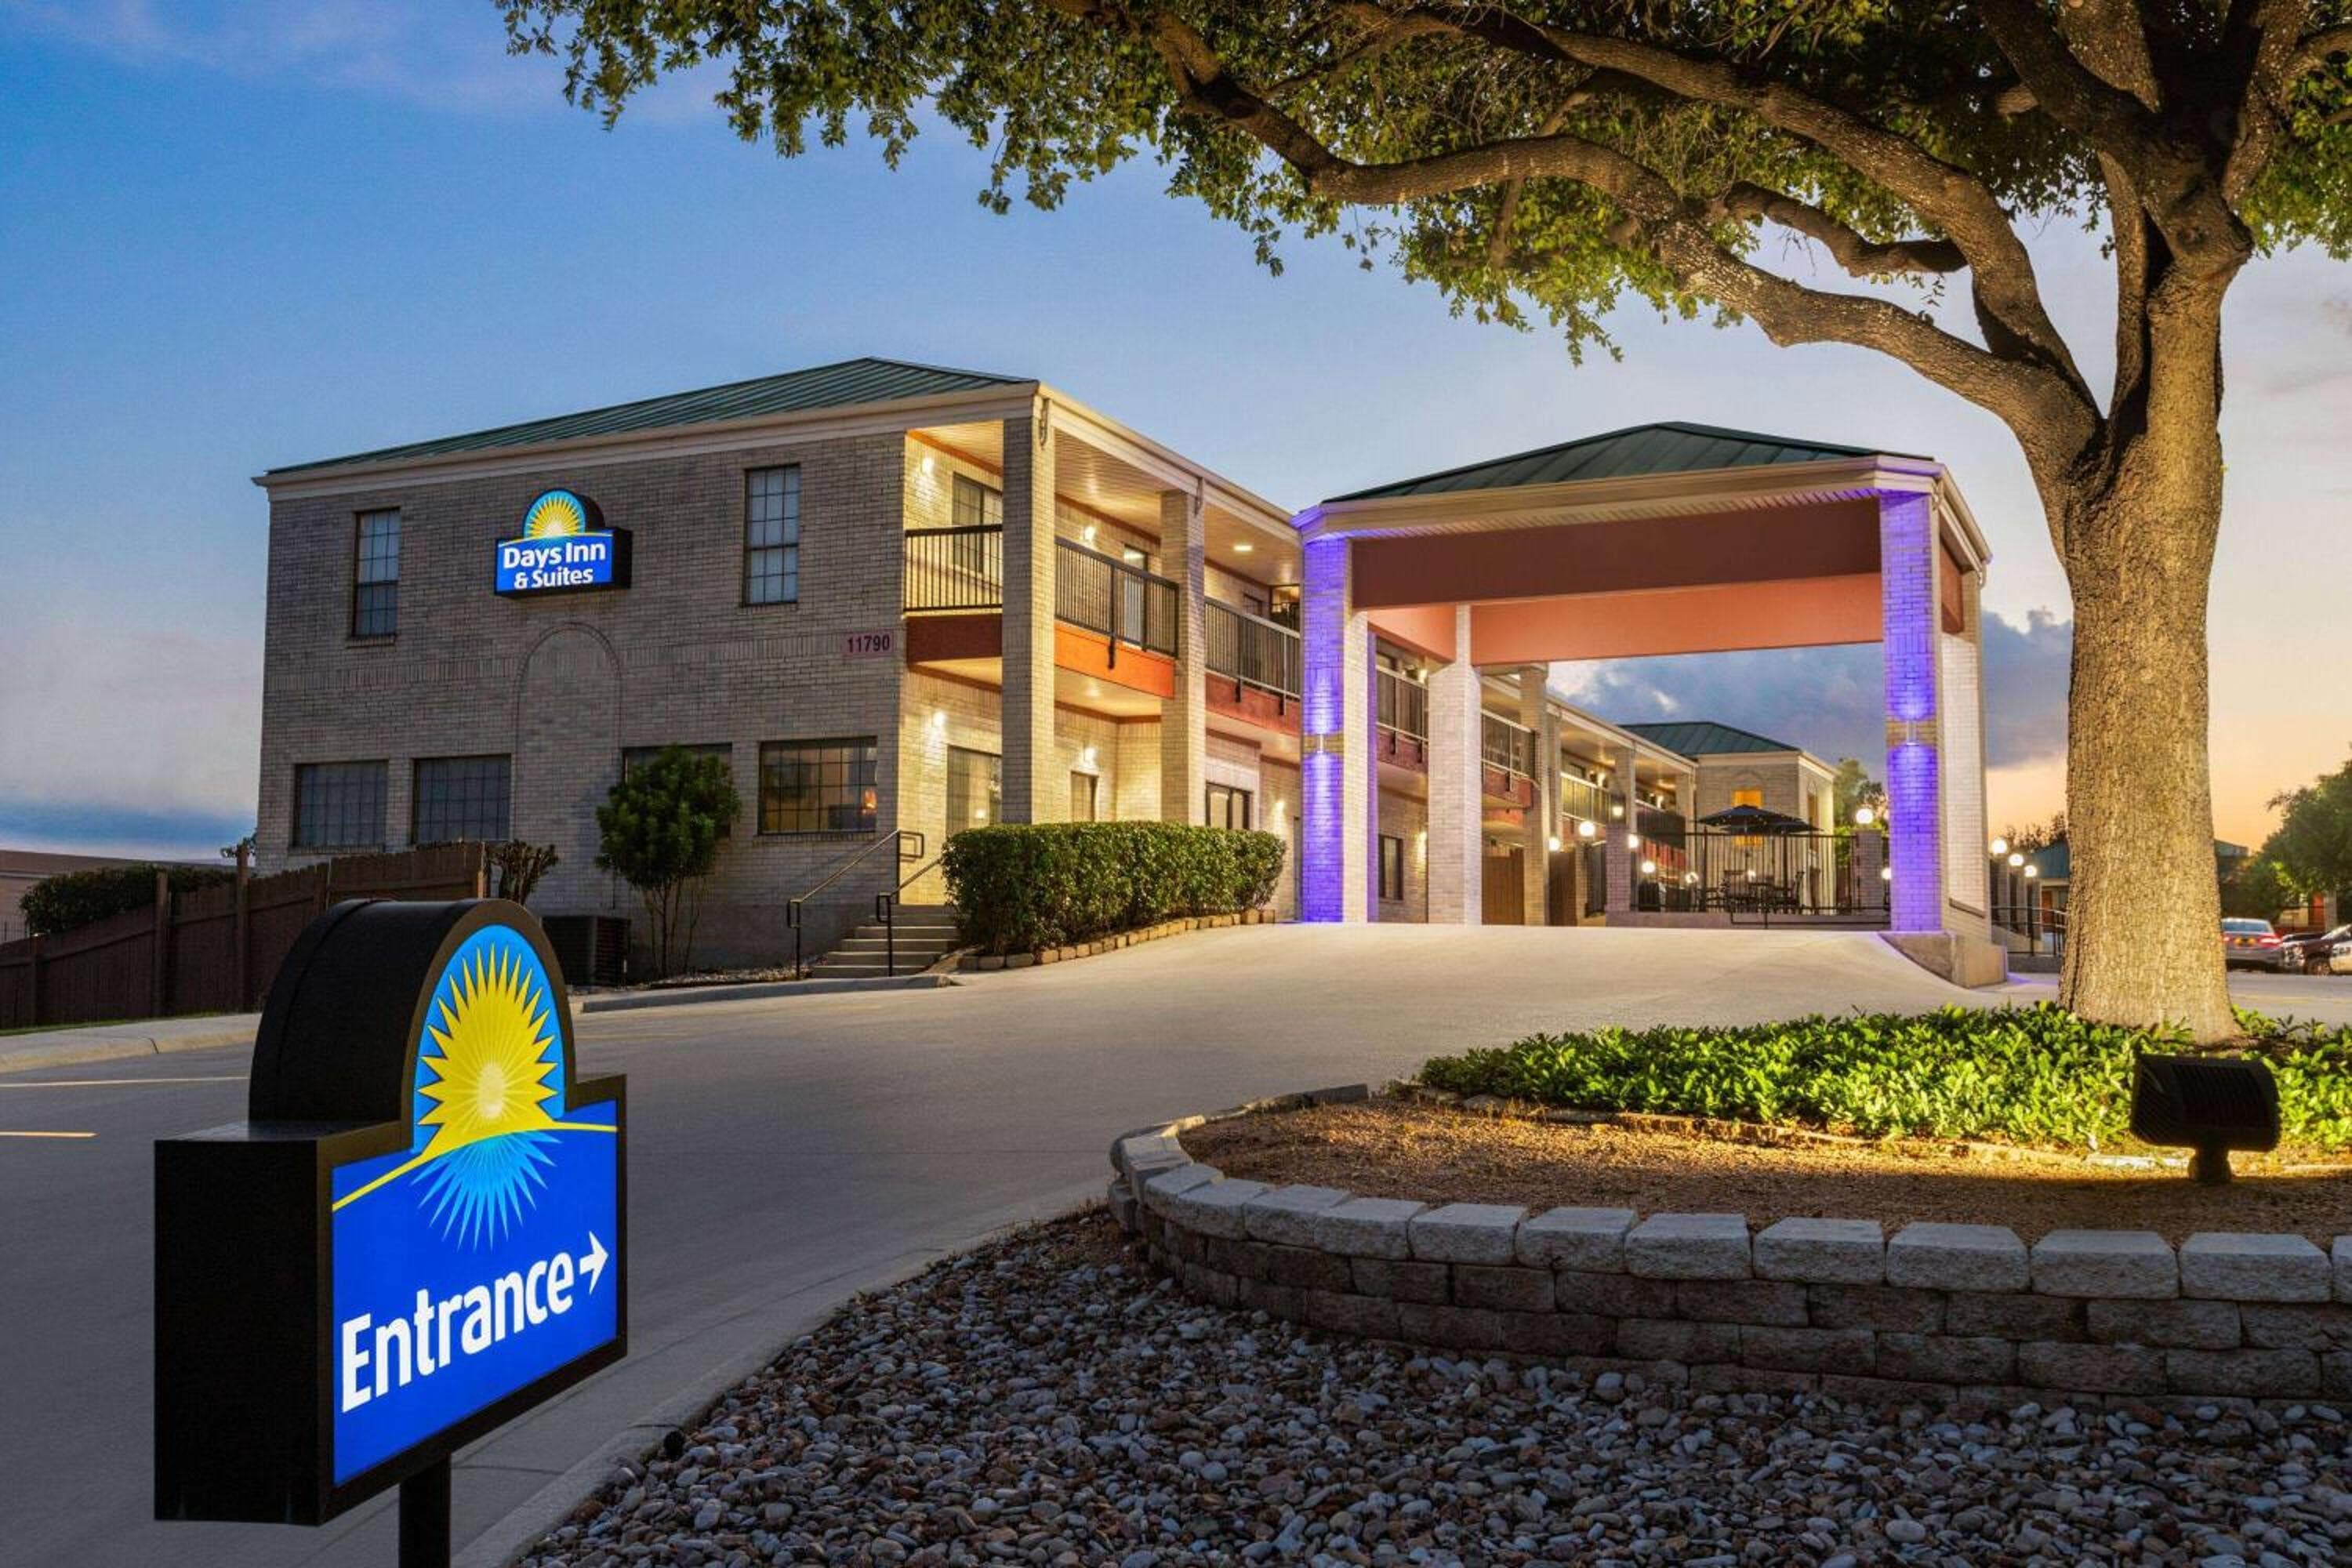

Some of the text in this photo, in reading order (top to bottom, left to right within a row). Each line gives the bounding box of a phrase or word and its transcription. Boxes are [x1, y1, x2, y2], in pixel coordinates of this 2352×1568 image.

[503, 542, 606, 568] Days Inn
[514, 566, 593, 589] & Suites
[848, 634, 890, 652] 11790
[340, 1251, 574, 1414] Entrance
